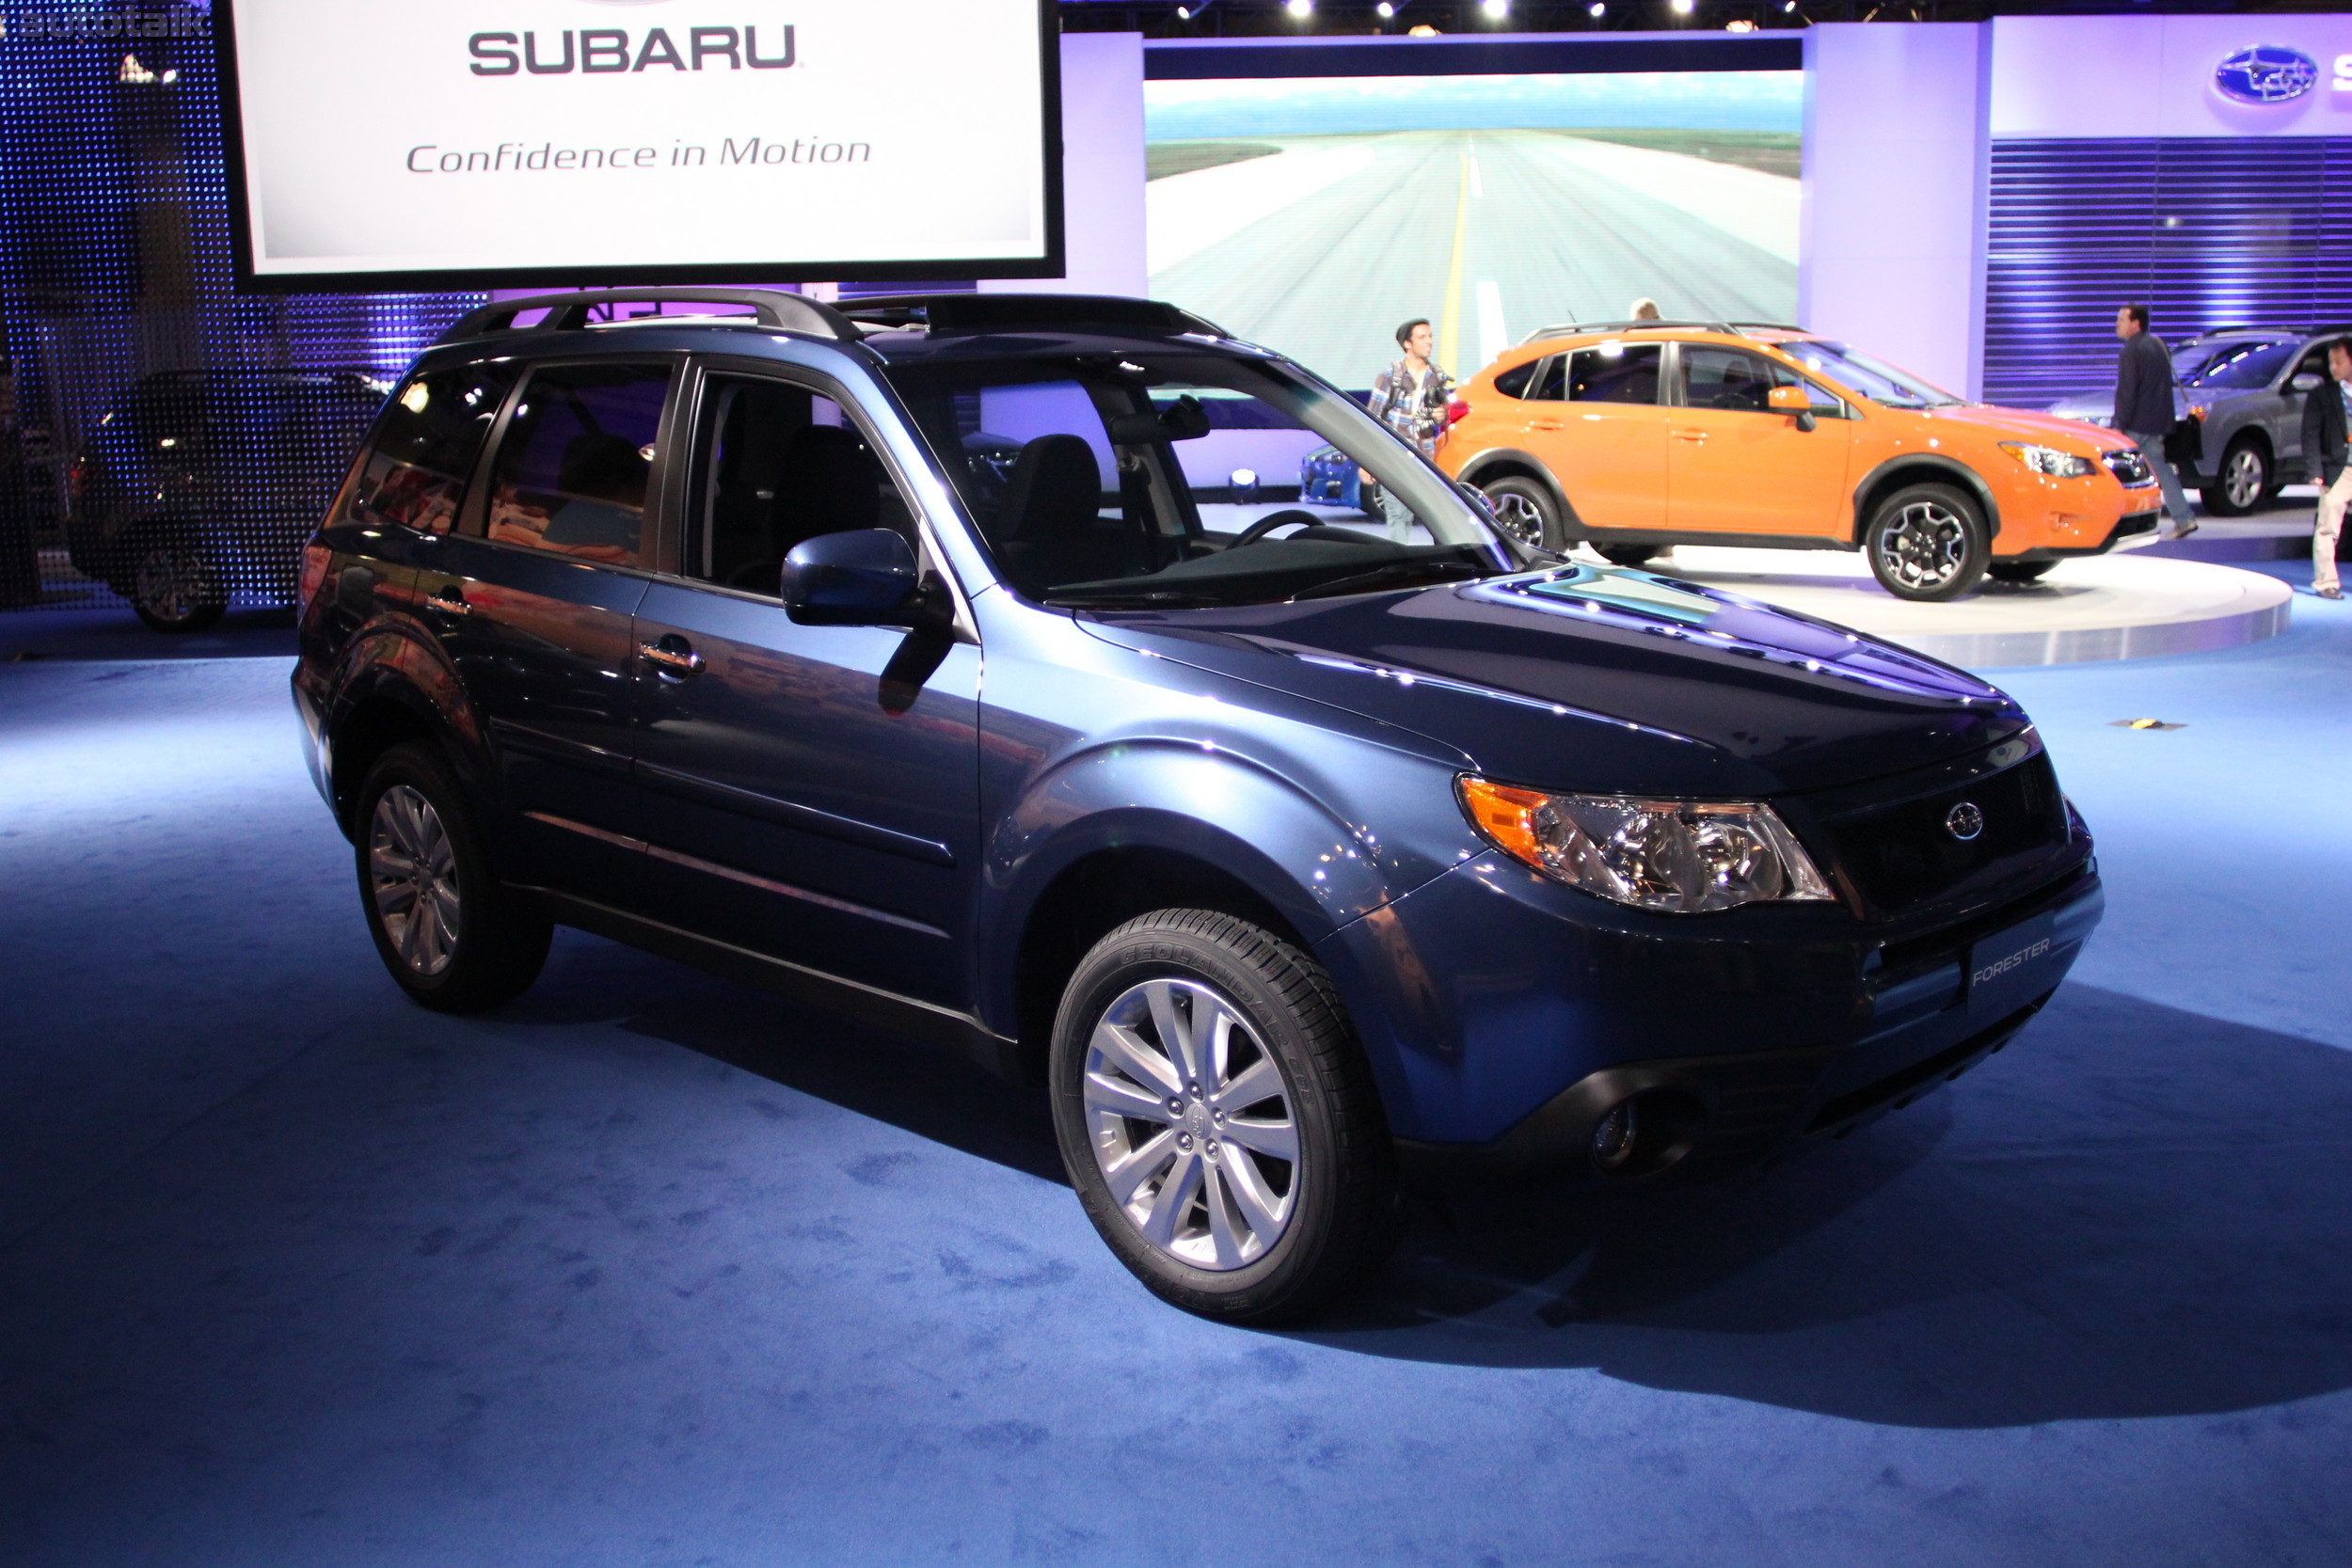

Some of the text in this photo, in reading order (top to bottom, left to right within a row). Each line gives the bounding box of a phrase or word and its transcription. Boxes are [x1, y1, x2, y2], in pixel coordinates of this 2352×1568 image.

[469, 24, 796, 76] SUBARU
[406, 136, 870, 172] Confidence in Motion
[1973, 938, 2050, 987] FORESTER
